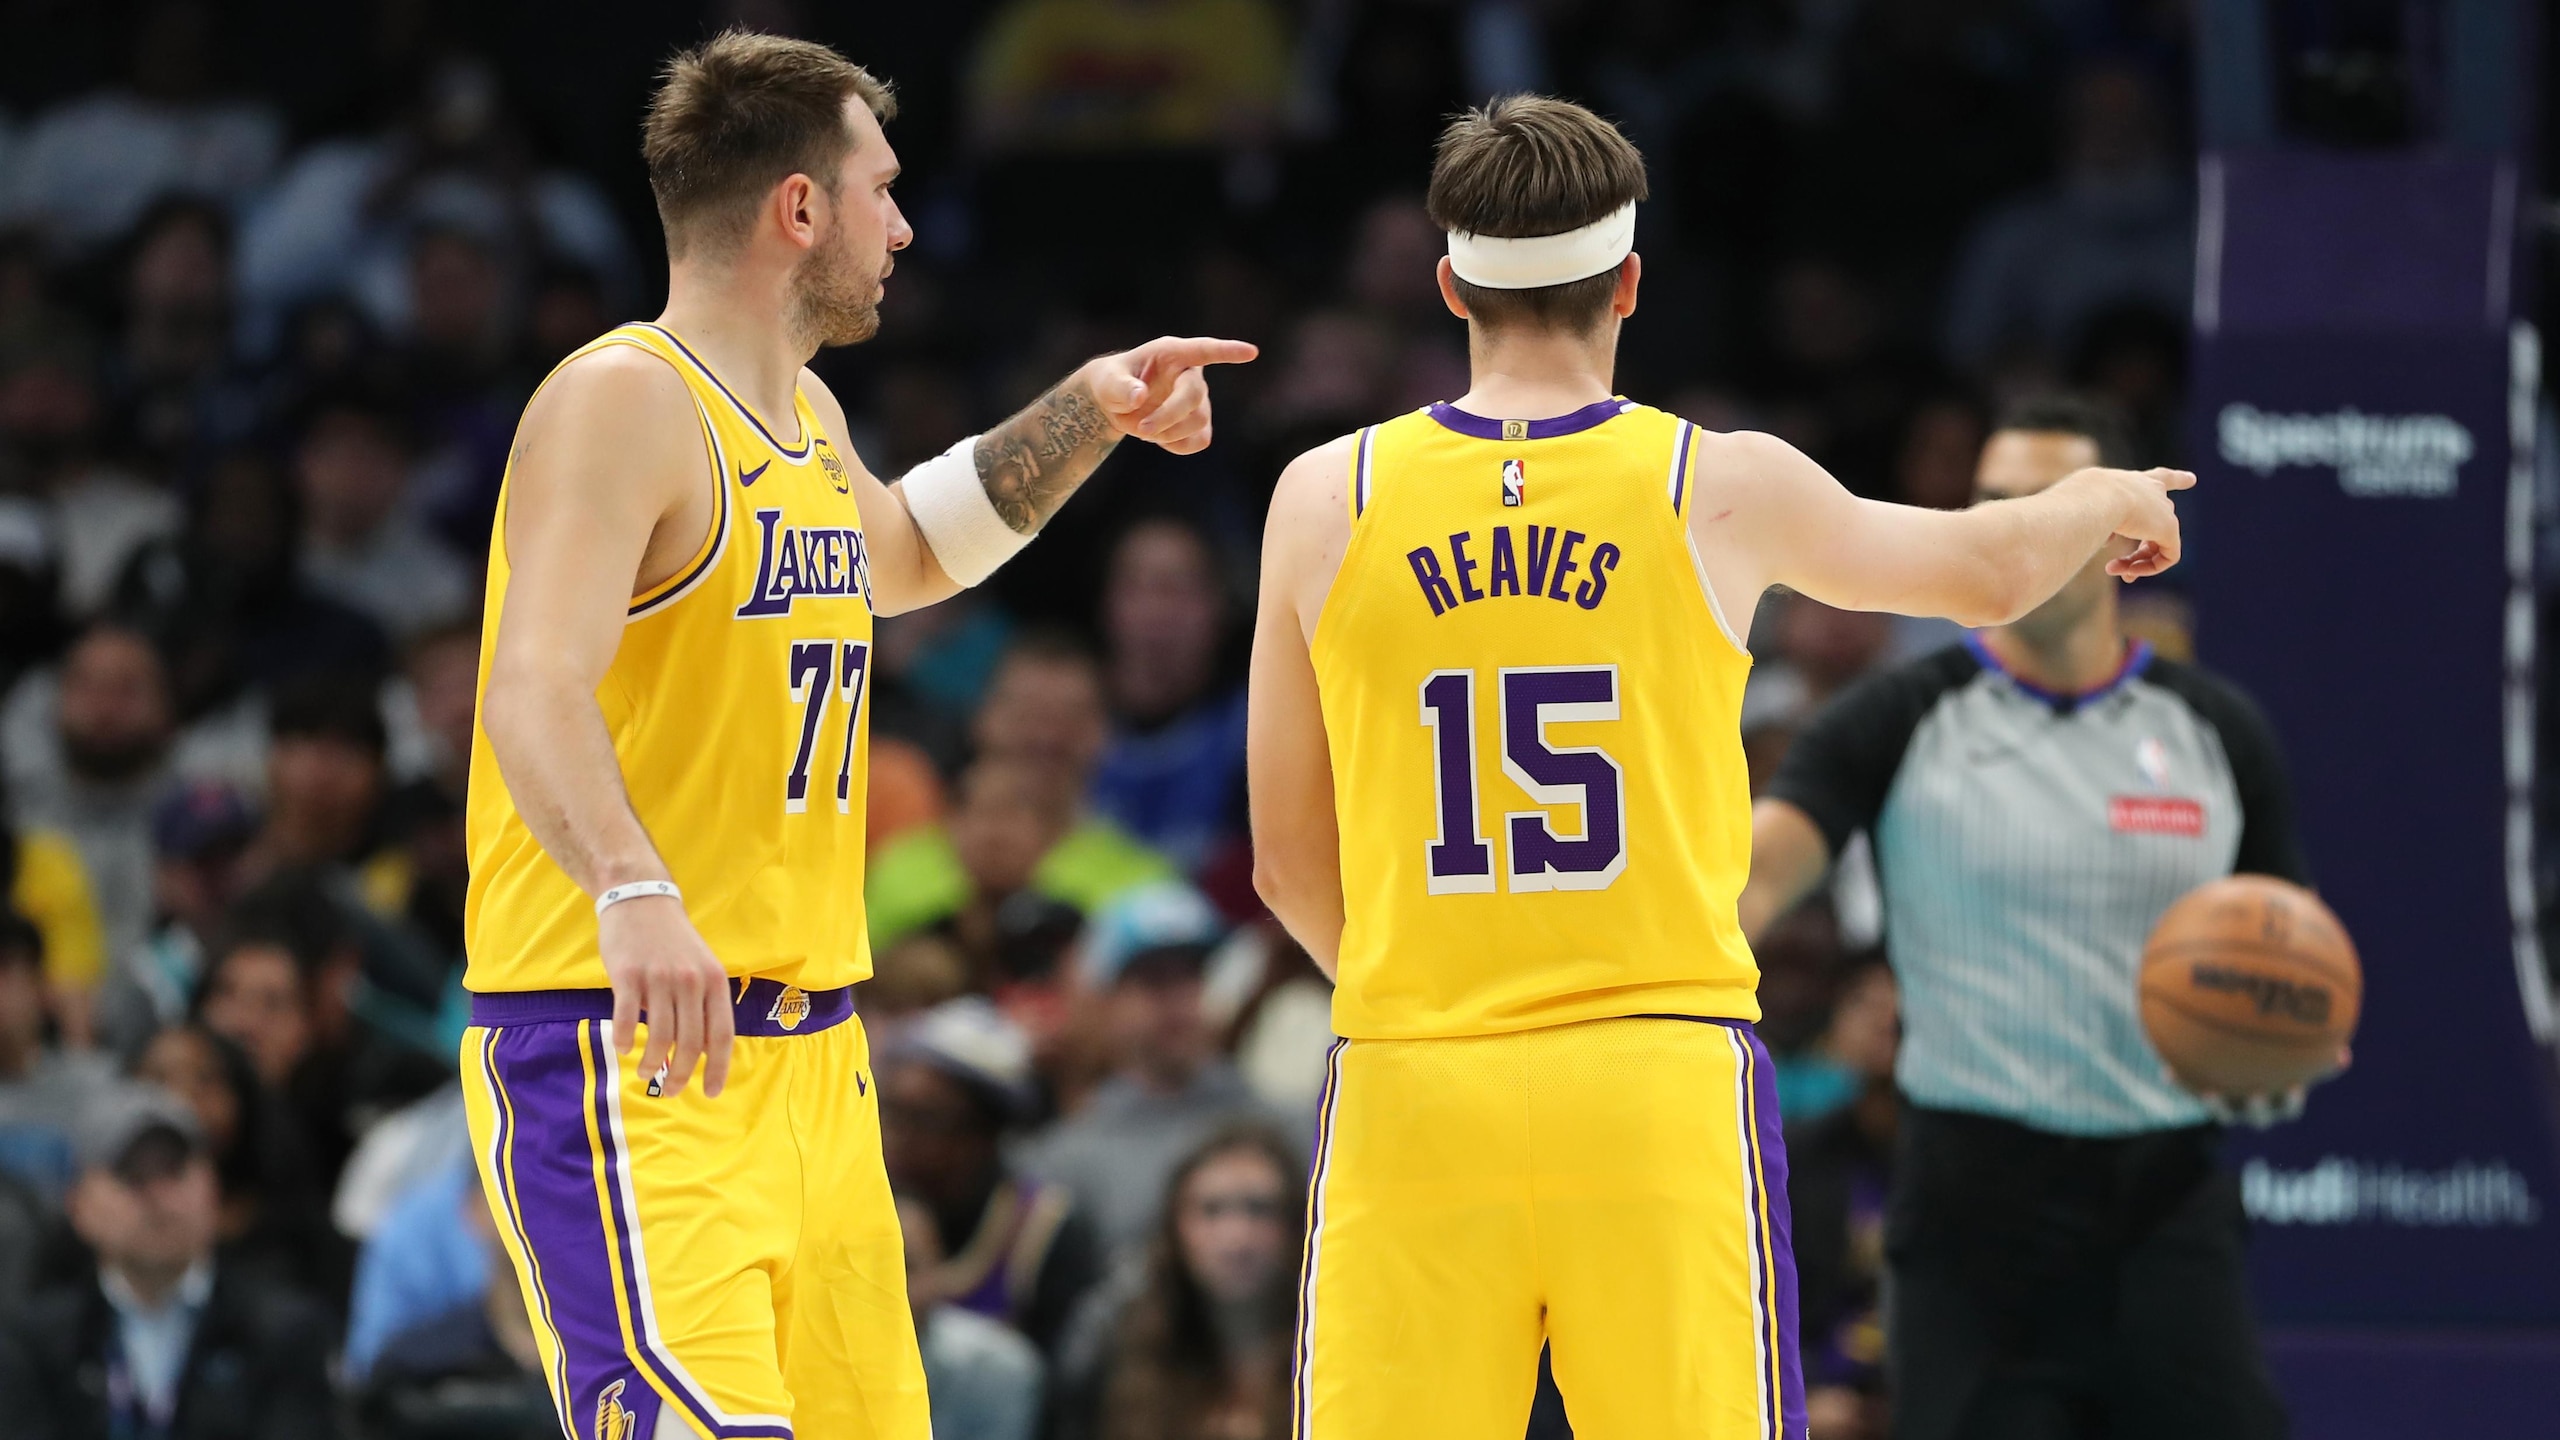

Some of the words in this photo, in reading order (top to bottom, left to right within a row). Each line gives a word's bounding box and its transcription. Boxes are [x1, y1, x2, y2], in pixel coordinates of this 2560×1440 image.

[1406, 524, 1621, 617] REAVES
[785, 638, 870, 814] 77
[1418, 664, 1627, 896] 15
[772, 996, 809, 1018] LAKERS
